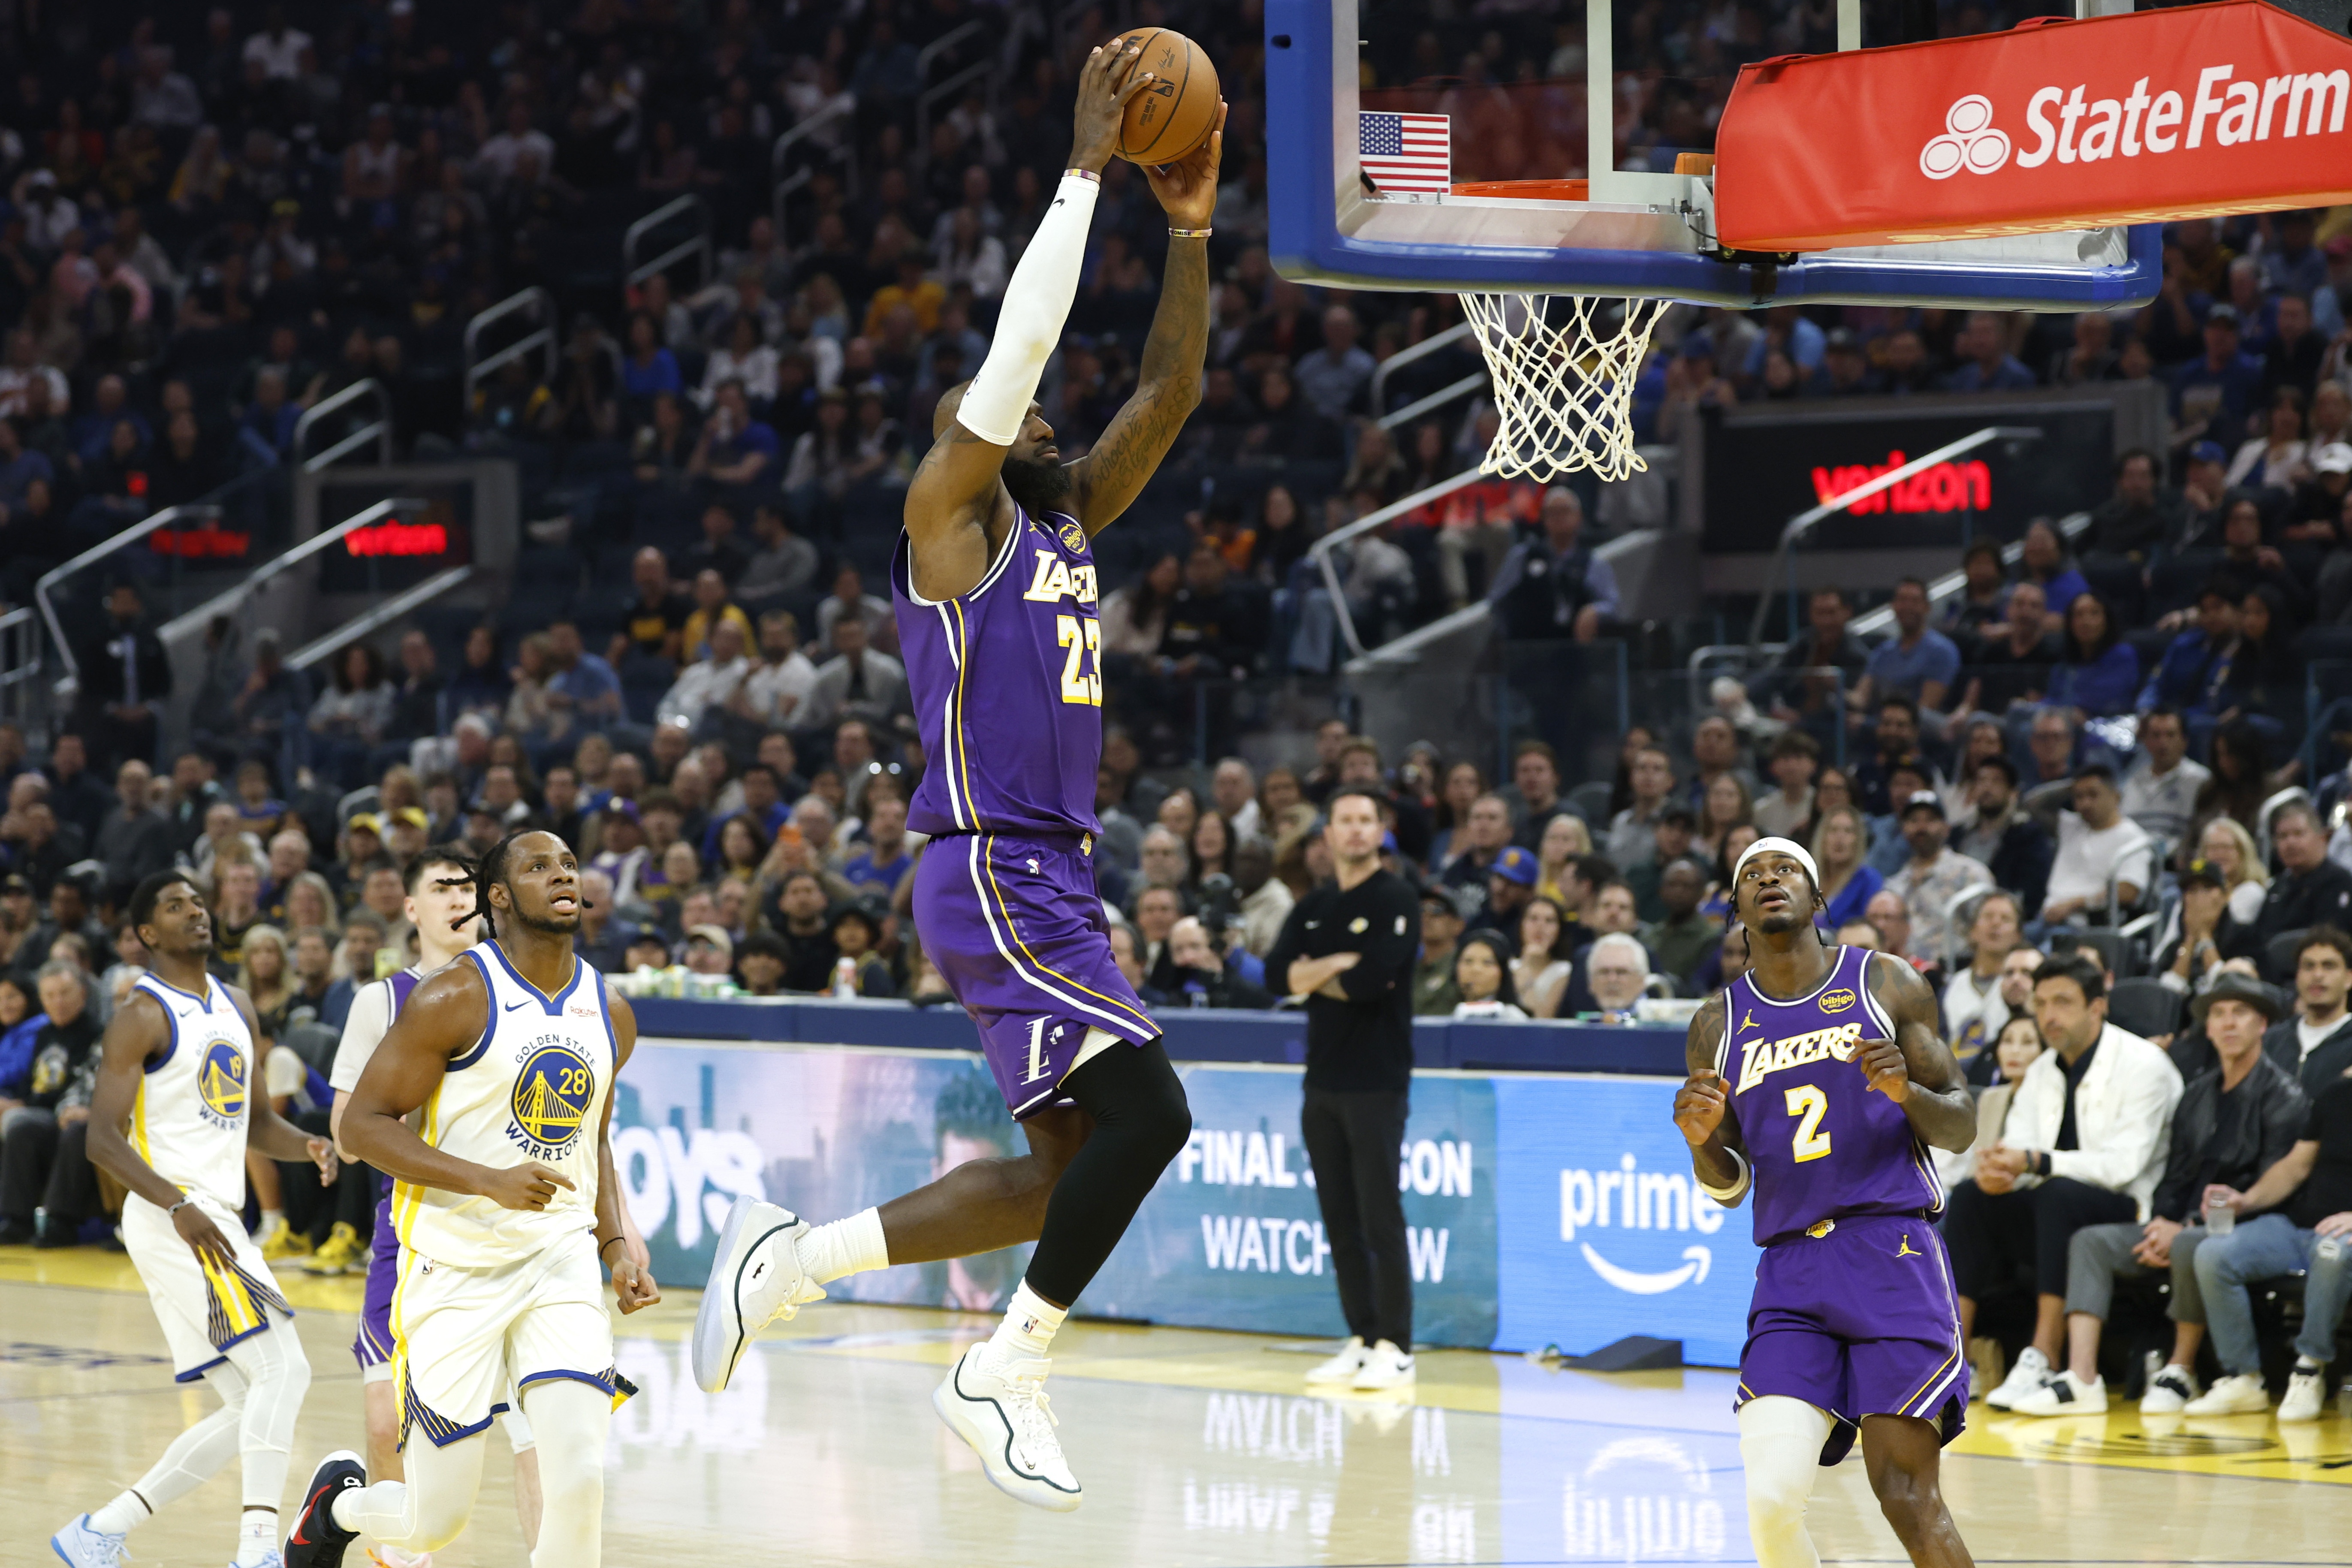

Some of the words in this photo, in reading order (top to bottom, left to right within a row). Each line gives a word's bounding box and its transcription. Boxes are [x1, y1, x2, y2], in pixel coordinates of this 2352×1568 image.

[1063, 530, 1081, 547] bibigo
[1023, 549, 1098, 609] LAER
[1057, 615, 1103, 707] 23
[570, 1006, 599, 1017] Rakuten
[1822, 995, 1853, 1006] bibigo
[229, 1055, 243, 1079] 19
[515, 1034, 560, 1064] GOLDEN
[566, 1037, 596, 1067] STATE
[1736, 1022, 1862, 1096] LAKERS
[559, 1067, 587, 1095] 28
[1784, 1084, 1832, 1164] 2
[612, 1126, 769, 1250] OYS
[1179, 1128, 1297, 1188] FINAL
[1559, 1152, 1725, 1242] prime
[1201, 1214, 1331, 1276] WATCH
